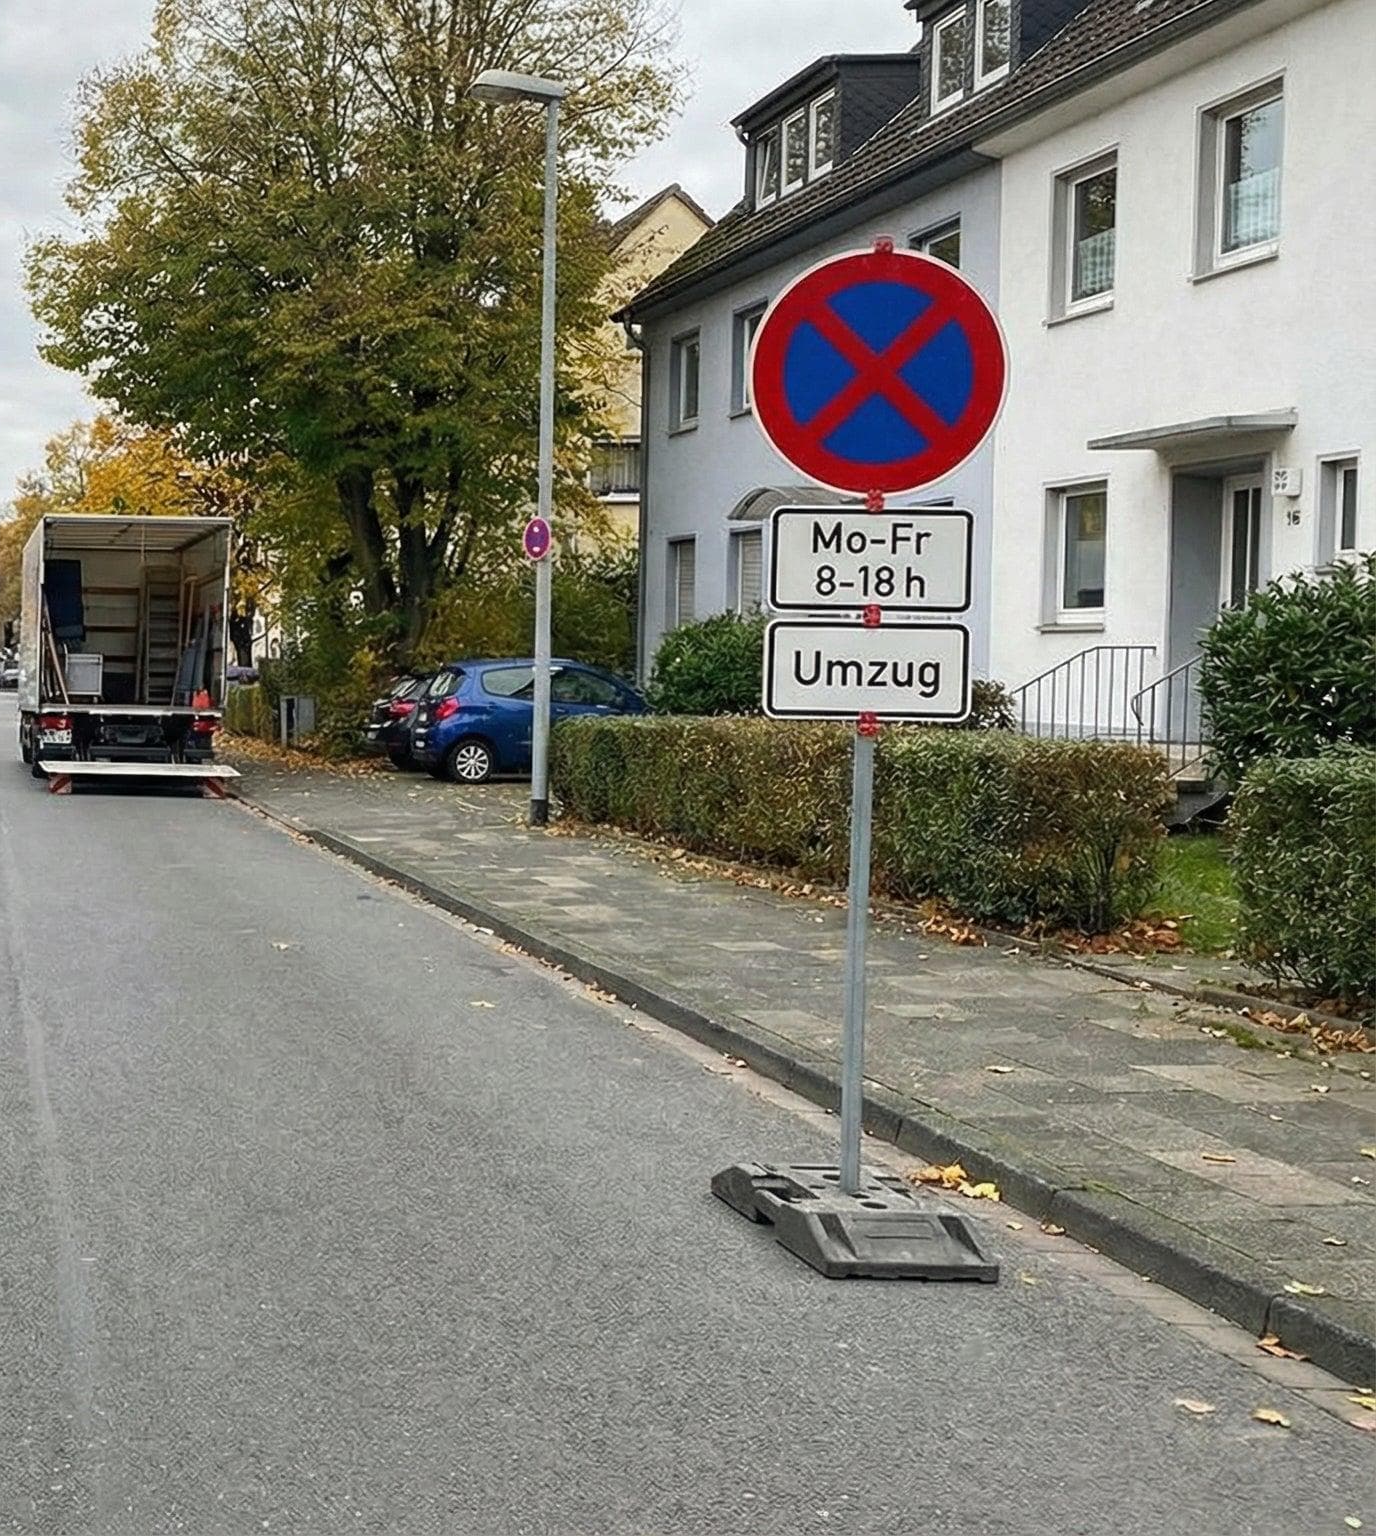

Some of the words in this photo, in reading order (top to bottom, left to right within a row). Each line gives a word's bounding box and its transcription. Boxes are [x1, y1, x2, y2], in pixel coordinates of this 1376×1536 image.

[812, 521, 932, 556] Mo-Fr
[905, 566, 925, 598] h
[794, 650, 941, 699] Umzug
